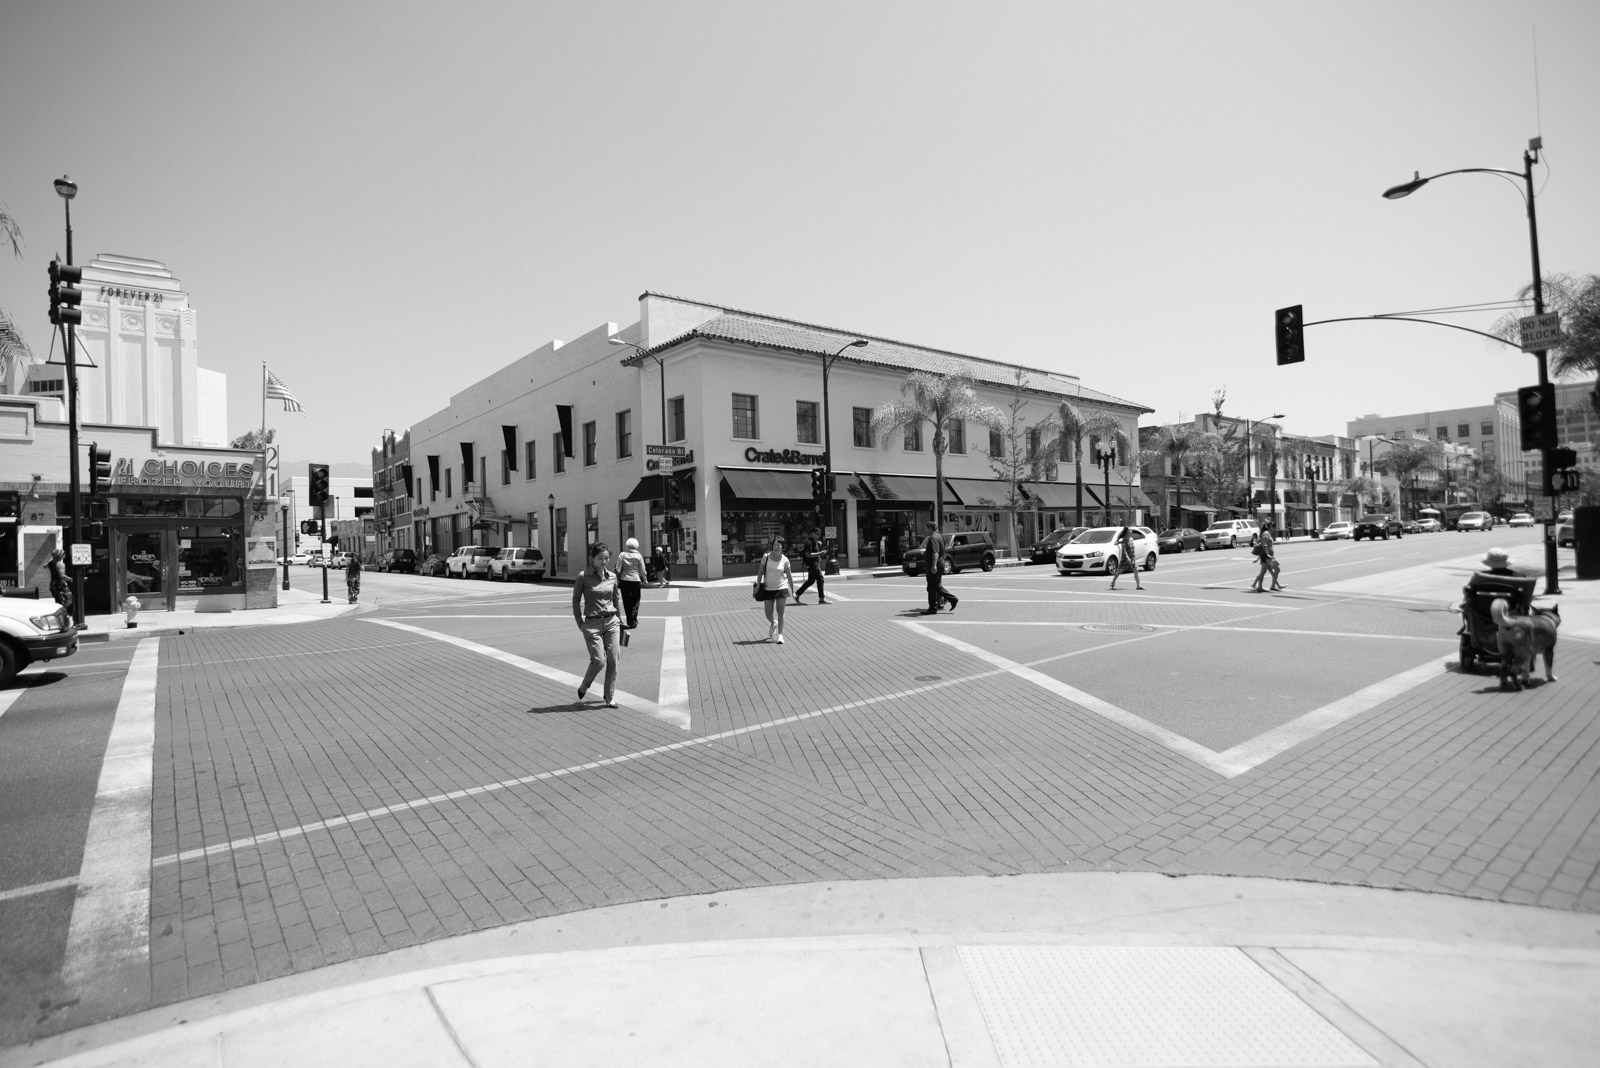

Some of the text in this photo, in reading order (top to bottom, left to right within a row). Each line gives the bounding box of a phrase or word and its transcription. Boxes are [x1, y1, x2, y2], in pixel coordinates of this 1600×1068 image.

[101, 286, 163, 303] FOREVER 21
[1522, 316, 1556, 331] DO NOT
[1522, 328, 1557, 342] BLOCK
[648, 446, 676, 455] Colorado
[744, 446, 827, 466] Crate&Barrel
[117, 457, 254, 479] 21 CHOICES
[117, 476, 252, 489] FROZEN YOGURT
[30, 512, 45, 521] 87
[254, 514, 265, 522] 85
